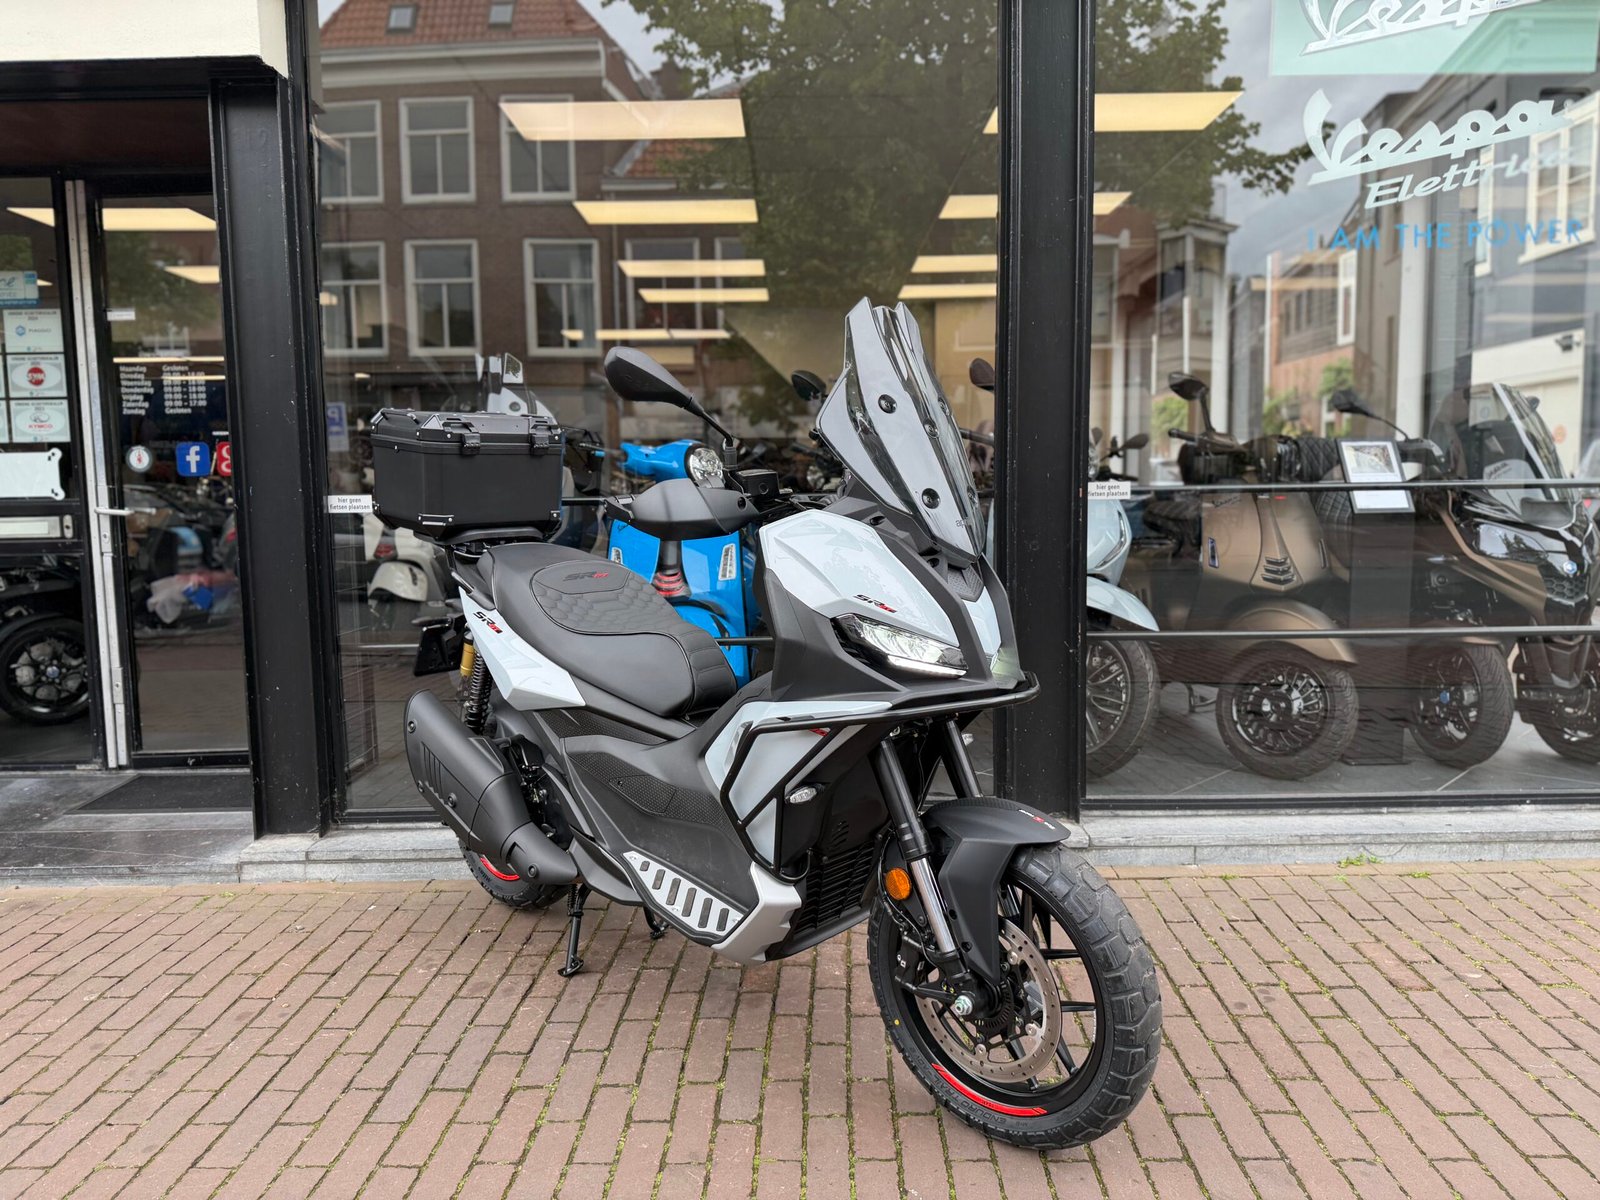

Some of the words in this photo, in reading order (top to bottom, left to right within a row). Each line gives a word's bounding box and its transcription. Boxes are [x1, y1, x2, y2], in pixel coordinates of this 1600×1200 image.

[1300, 0, 1541, 55] Vesp
[1303, 89, 1576, 185] Vespa
[1331, 227, 1380, 248] AM
[1395, 223, 1450, 248] THE
[1467, 219, 1584, 248] POWER
